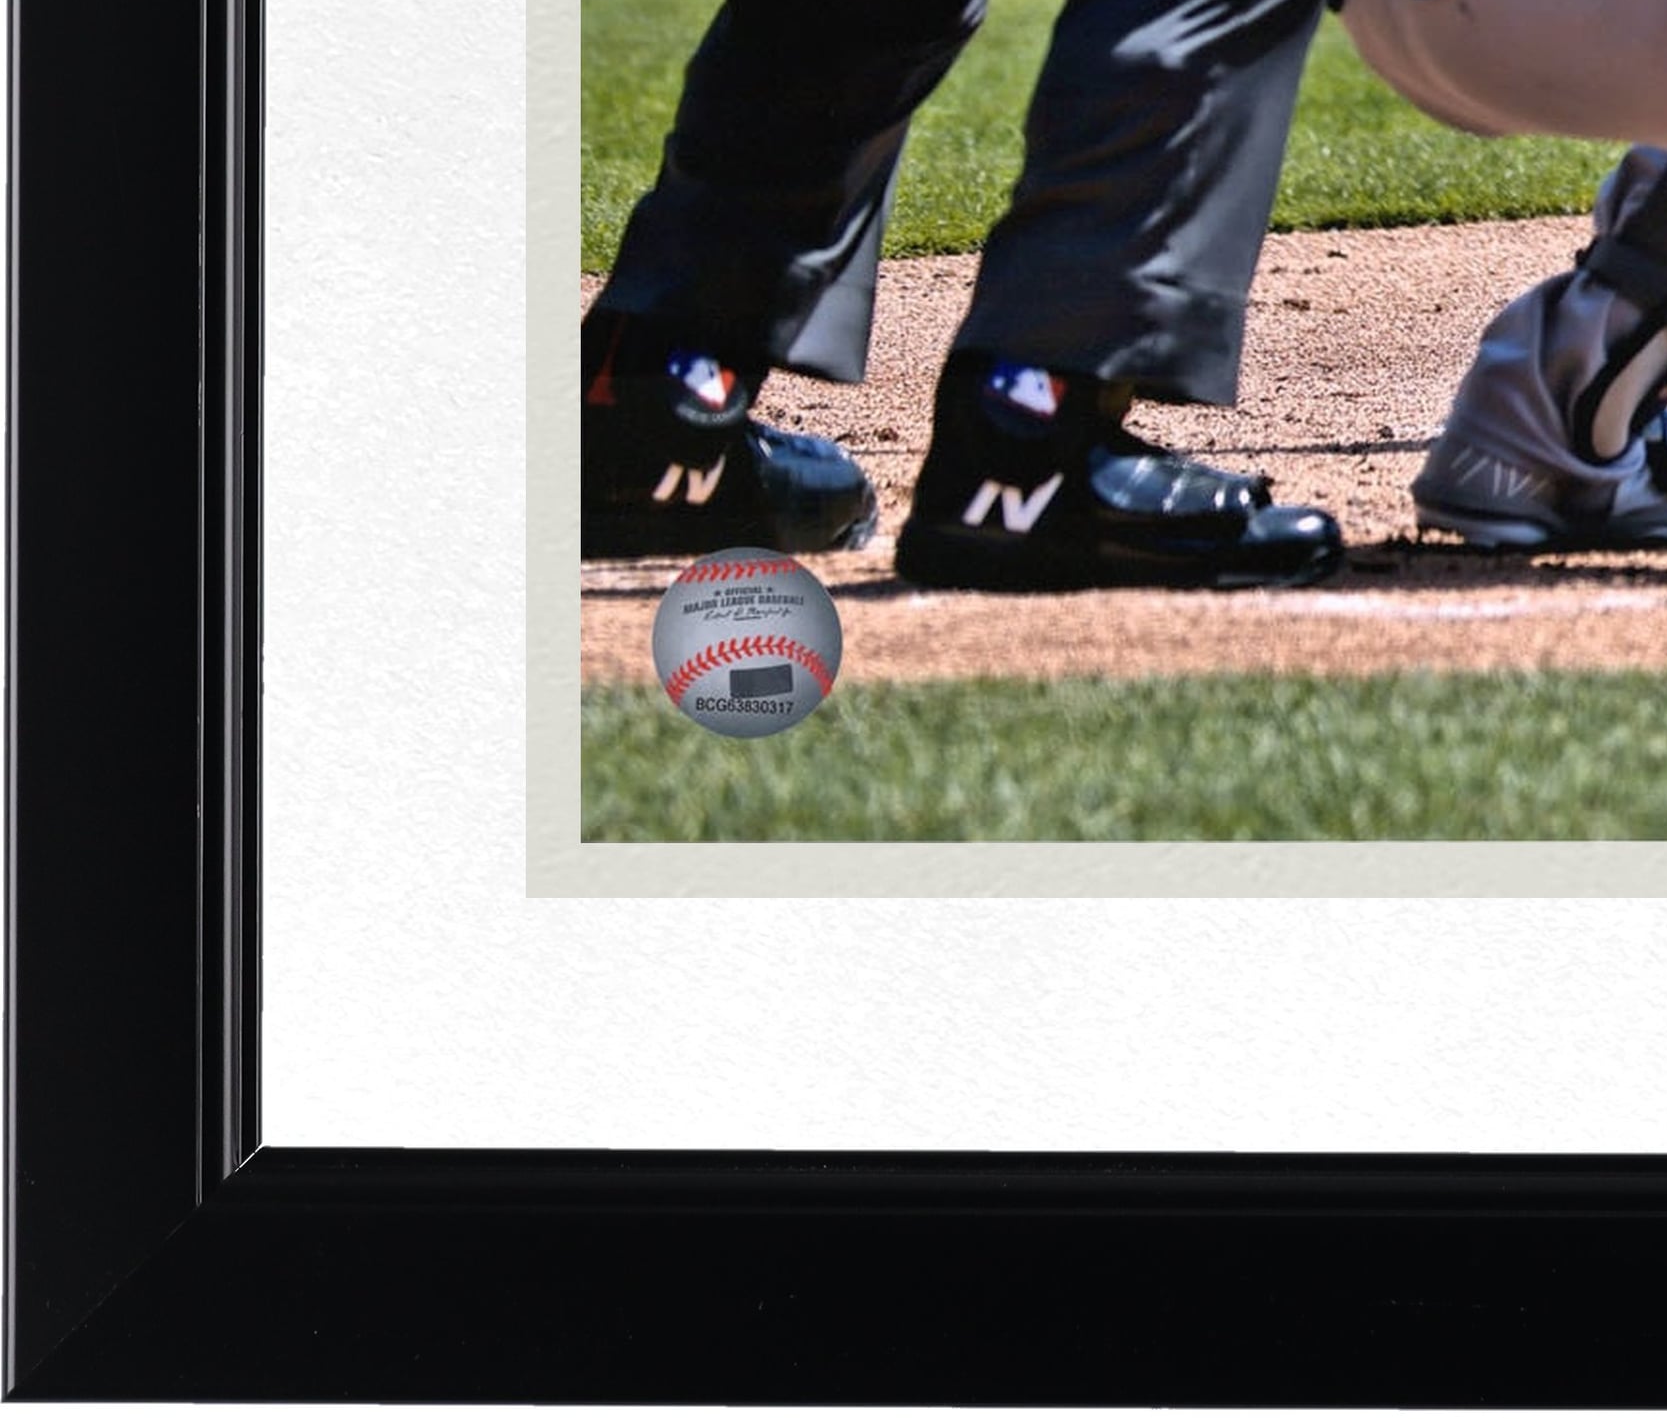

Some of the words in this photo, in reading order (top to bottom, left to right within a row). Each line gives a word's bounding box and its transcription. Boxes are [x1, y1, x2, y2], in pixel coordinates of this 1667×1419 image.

[684, 599, 718, 614] MAJOR
[721, 596, 755, 607] LEAGUE
[758, 595, 804, 605] BASEBALL
